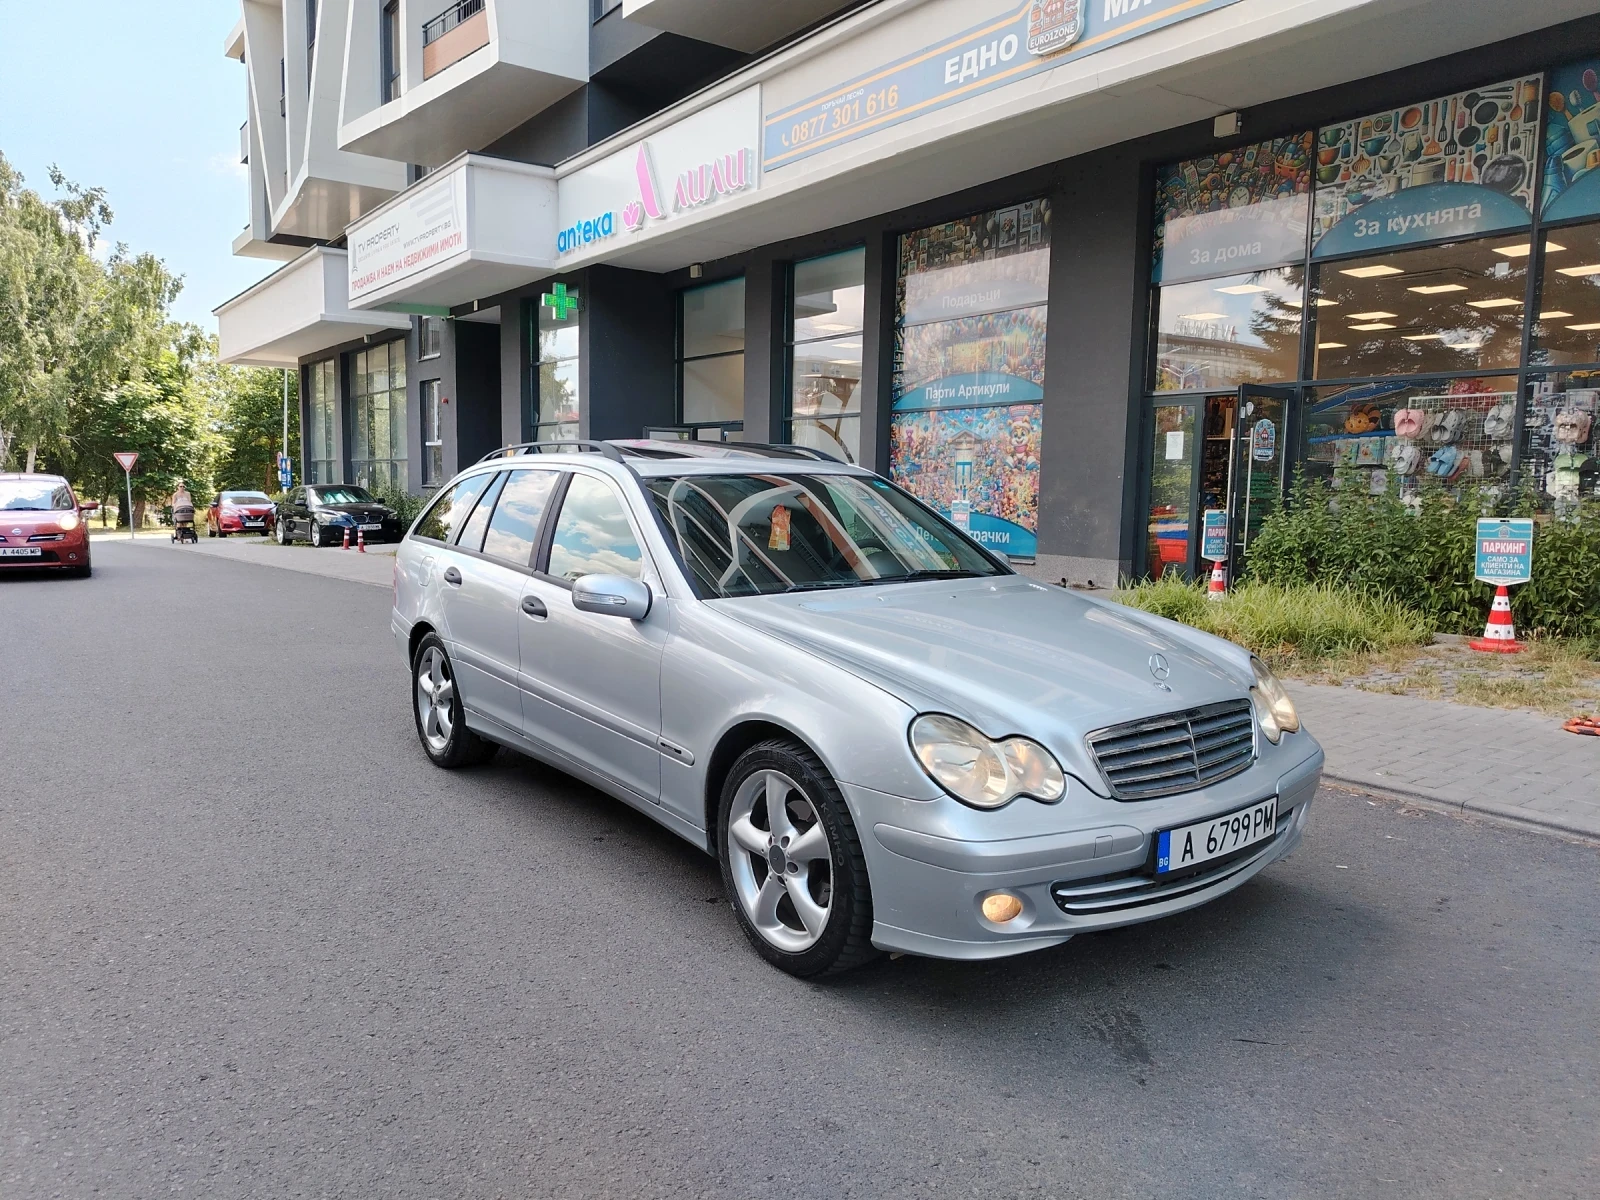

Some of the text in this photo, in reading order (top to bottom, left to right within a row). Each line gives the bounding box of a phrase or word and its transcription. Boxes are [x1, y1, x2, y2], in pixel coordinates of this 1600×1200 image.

[1030, 23, 1075, 49] EURO1ZONE
[944, 33, 1018, 86] ЕДНО
[846, 88, 864, 102] ЛЕСНО
[791, 84, 899, 146] 0877 301 616
[1354, 199, 1481, 238] За кухнята
[366, 222, 400, 250] PROPERTY
[352, 272, 377, 292] ПРОДАЖБА
[381, 263, 395, 279] НАЕМ
[395, 259, 404, 272] НА
[404, 243, 439, 268] НЕДВИЖИМИ
[439, 231, 462, 252] ИМОТИ
[1189, 239, 1262, 265] За дома
[942, 288, 1001, 309] Подаръци
[925, 382, 1010, 401] Парти Артикули
[1482, 541, 1525, 554] ПАРКИНГ
[1484, 568, 1521, 576] МАГАЗИНА
[820, 802, 845, 867] KUMHO
[1181, 831, 1194, 862] A
[1158, 857, 1169, 868] BG
